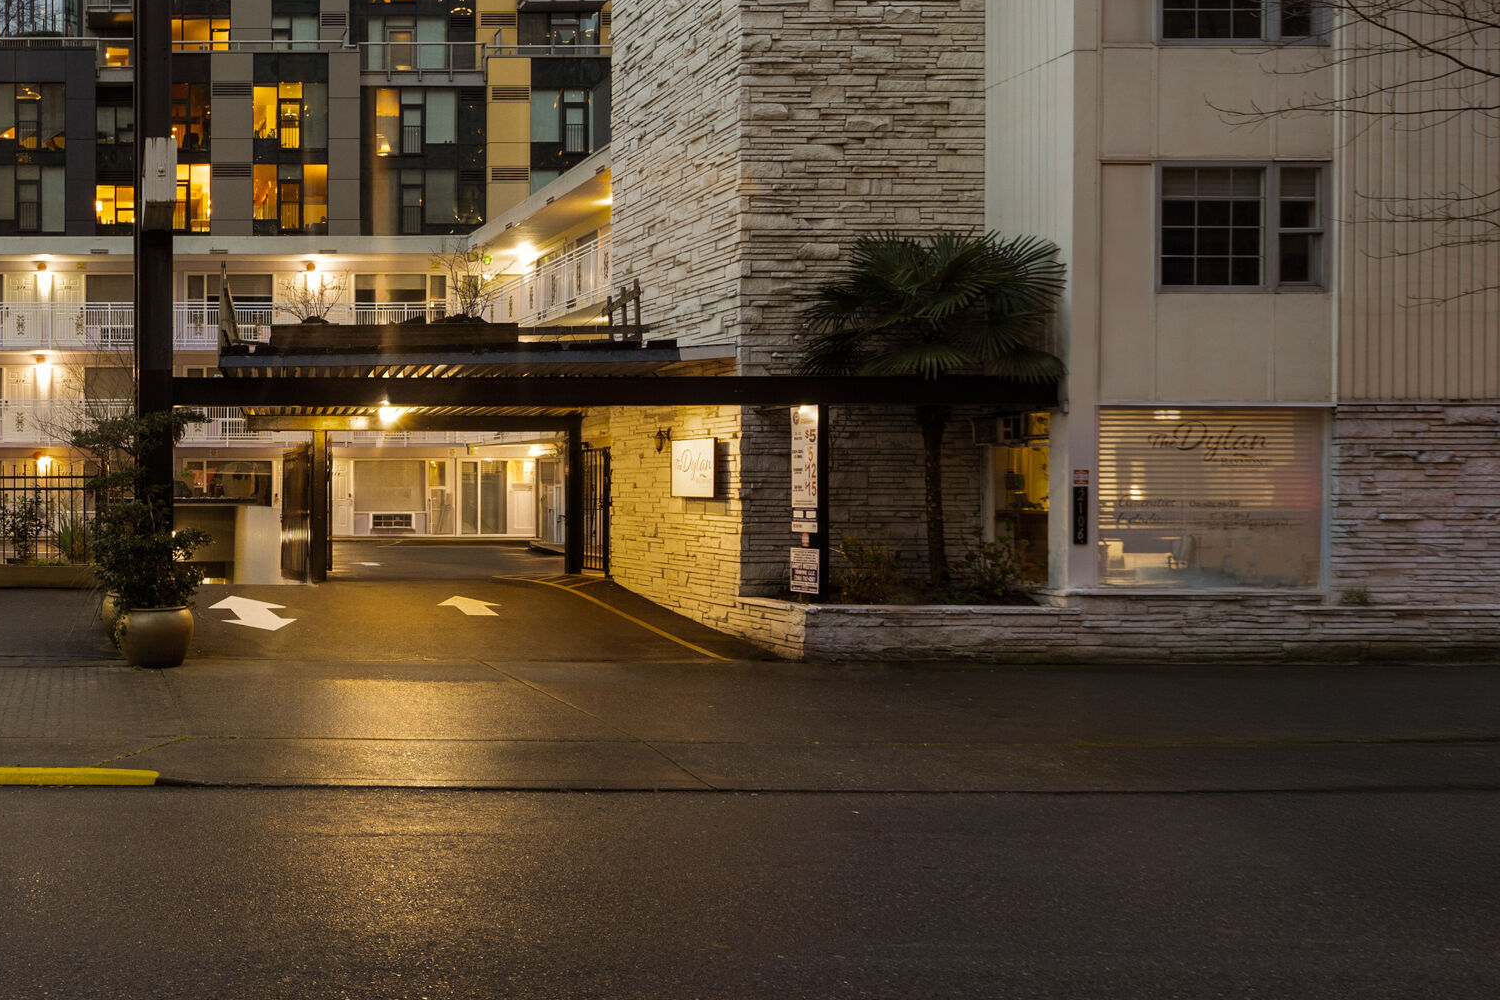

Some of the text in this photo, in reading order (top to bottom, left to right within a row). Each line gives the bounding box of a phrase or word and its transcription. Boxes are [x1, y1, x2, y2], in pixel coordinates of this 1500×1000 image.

[805, 429, 817, 443] $5
[1148, 420, 1269, 461] The Dylan
[681, 449, 712, 480] Dylan
